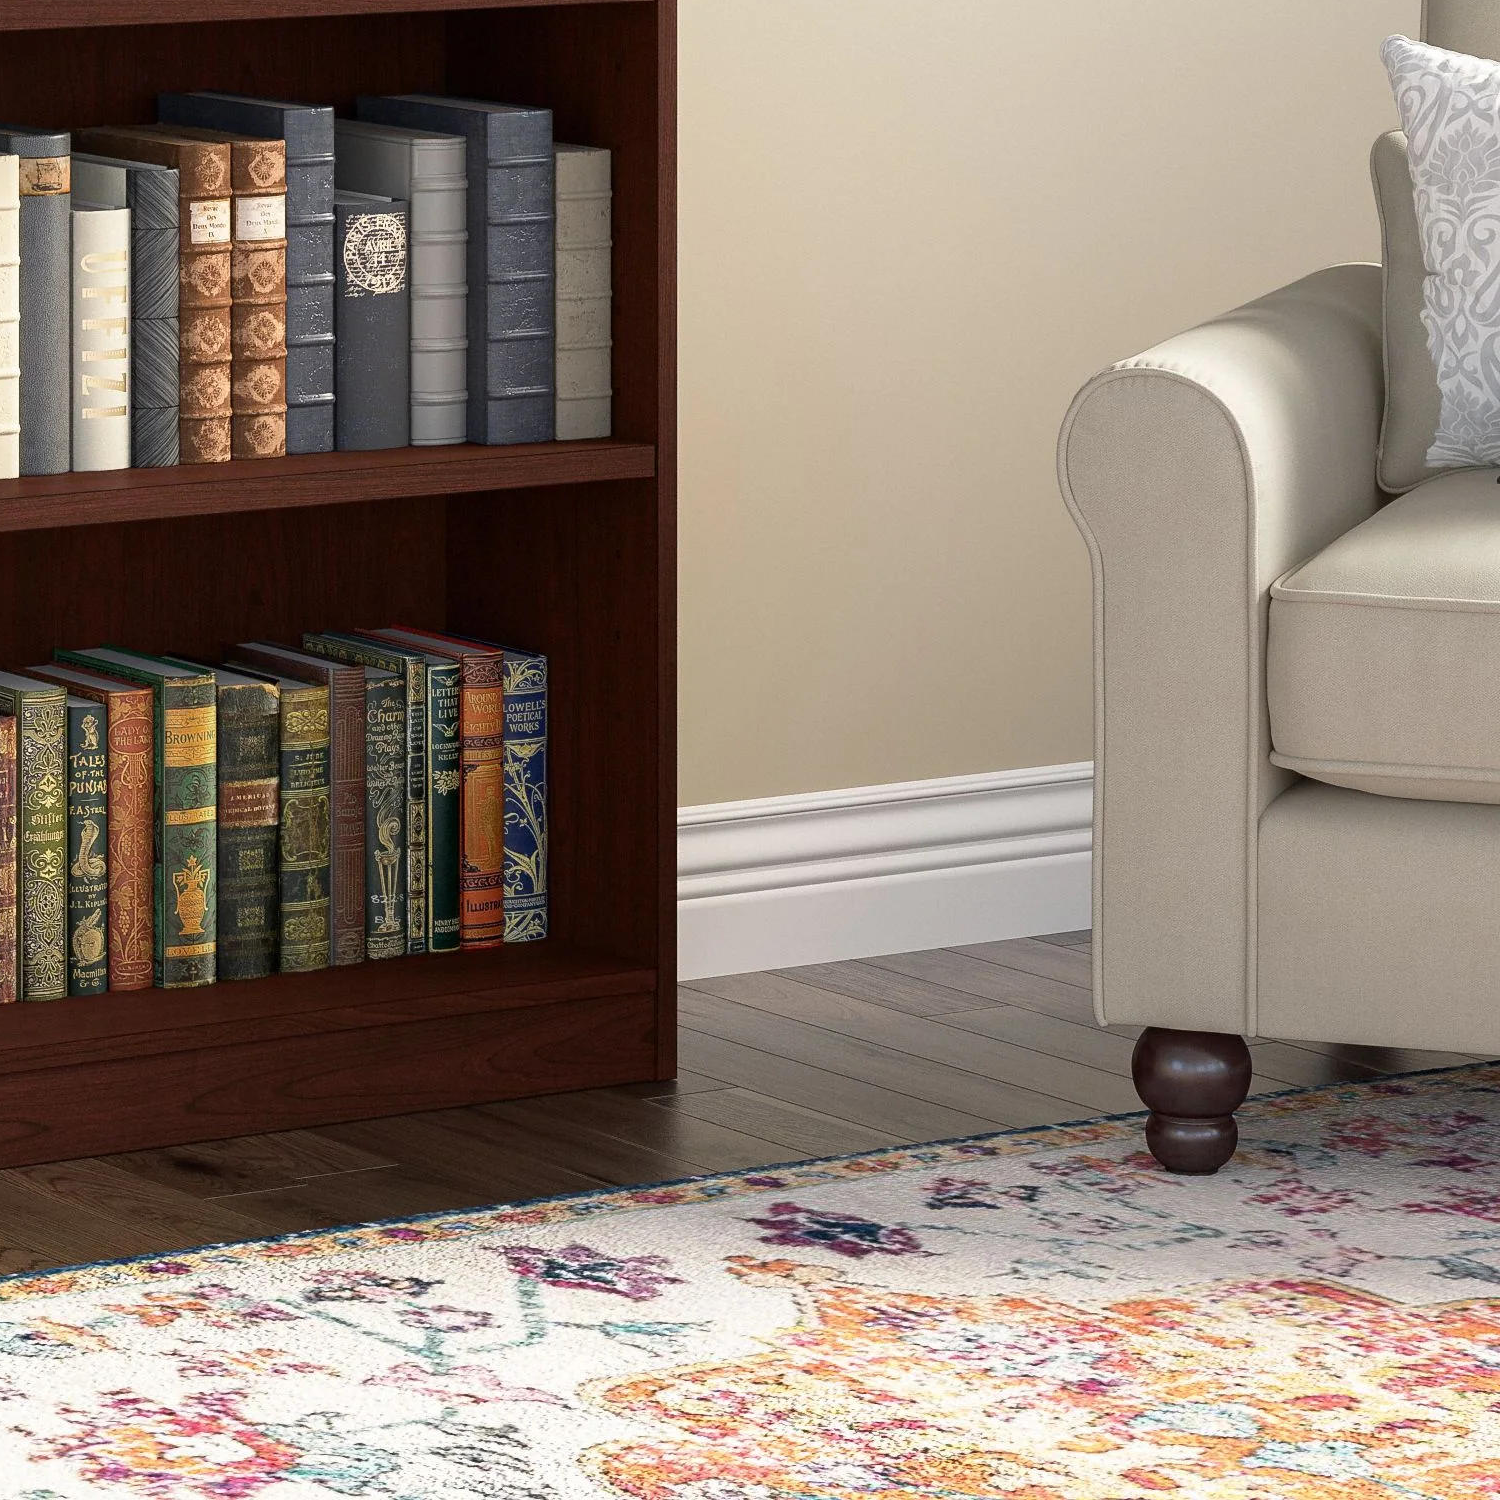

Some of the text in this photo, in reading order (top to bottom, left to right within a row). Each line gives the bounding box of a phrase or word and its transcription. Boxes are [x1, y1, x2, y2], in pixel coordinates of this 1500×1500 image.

[81, 251, 127, 420] UFFIZI
[381, 697, 395, 707] The
[438, 698, 458, 708] THAT
[503, 700, 546, 713] LOWELL'S
[367, 708, 404, 723] Charm
[438, 708, 458, 719] LIVE
[506, 711, 543, 723] POETICAL
[115, 727, 140, 737] LADY
[509, 722, 539, 734] WORKS
[114, 736, 131, 746] THE
[165, 730, 215, 745] BROWNING
[70, 753, 105, 768] TALES
[167, 945, 213, 956] LOVELL
